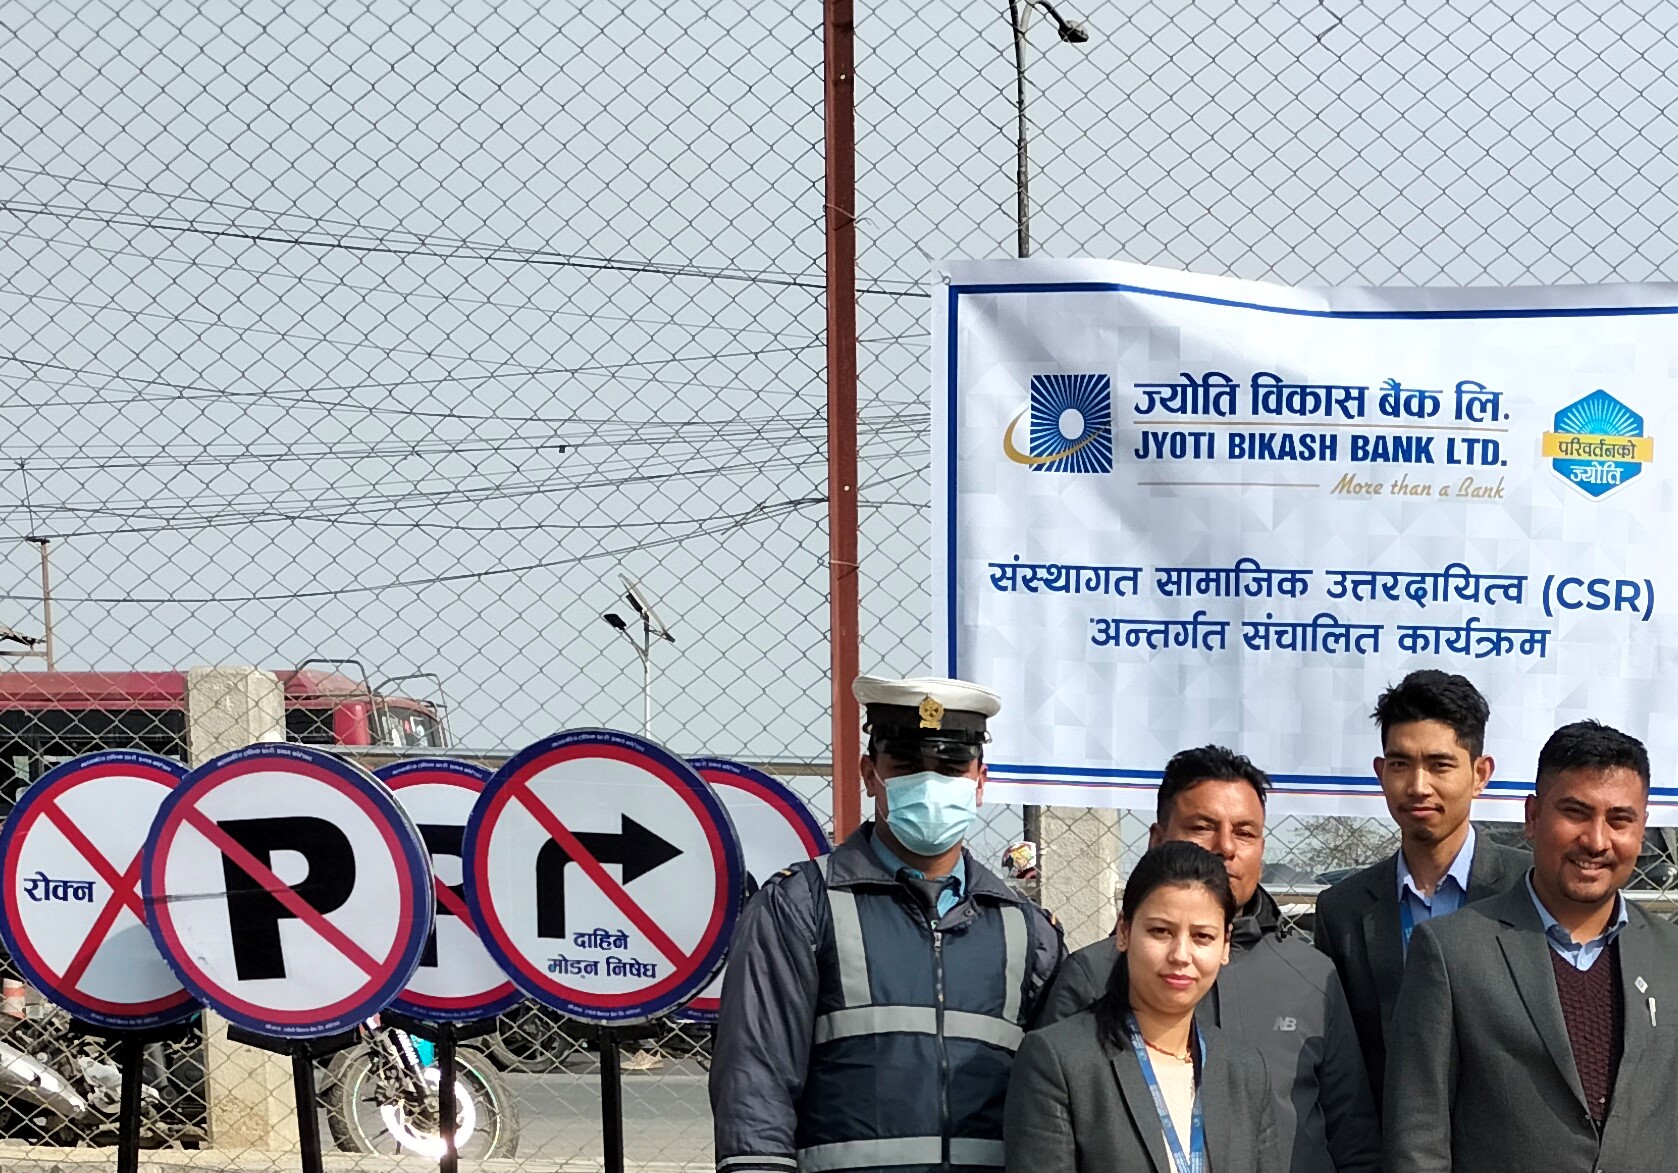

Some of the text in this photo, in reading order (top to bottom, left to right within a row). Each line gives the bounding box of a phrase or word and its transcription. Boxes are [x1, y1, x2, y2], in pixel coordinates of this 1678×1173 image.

[1134, 372, 1240, 417] ज्योति
[1250, 372, 1369, 419] विकास
[1454, 379, 1509, 422] लि.
[1134, 431, 1507, 467] JYOTI BIKASH BANK LTD.
[1558, 437, 1637, 459] परिवर्तनको
[1330, 472, 1504, 499] More than a Bank
[1570, 461, 1624, 485] ज्योति
[989, 554, 1656, 621] संस्थागत सामाजिक उत्तरदायित्व (CSR)
[1089, 610, 1552, 658] अन्तर्गत संचालित कार्यक्रम
[23, 870, 96, 903] रोक्न
[572, 927, 630, 950] दाहिने
[605, 955, 657, 979] निषेध
